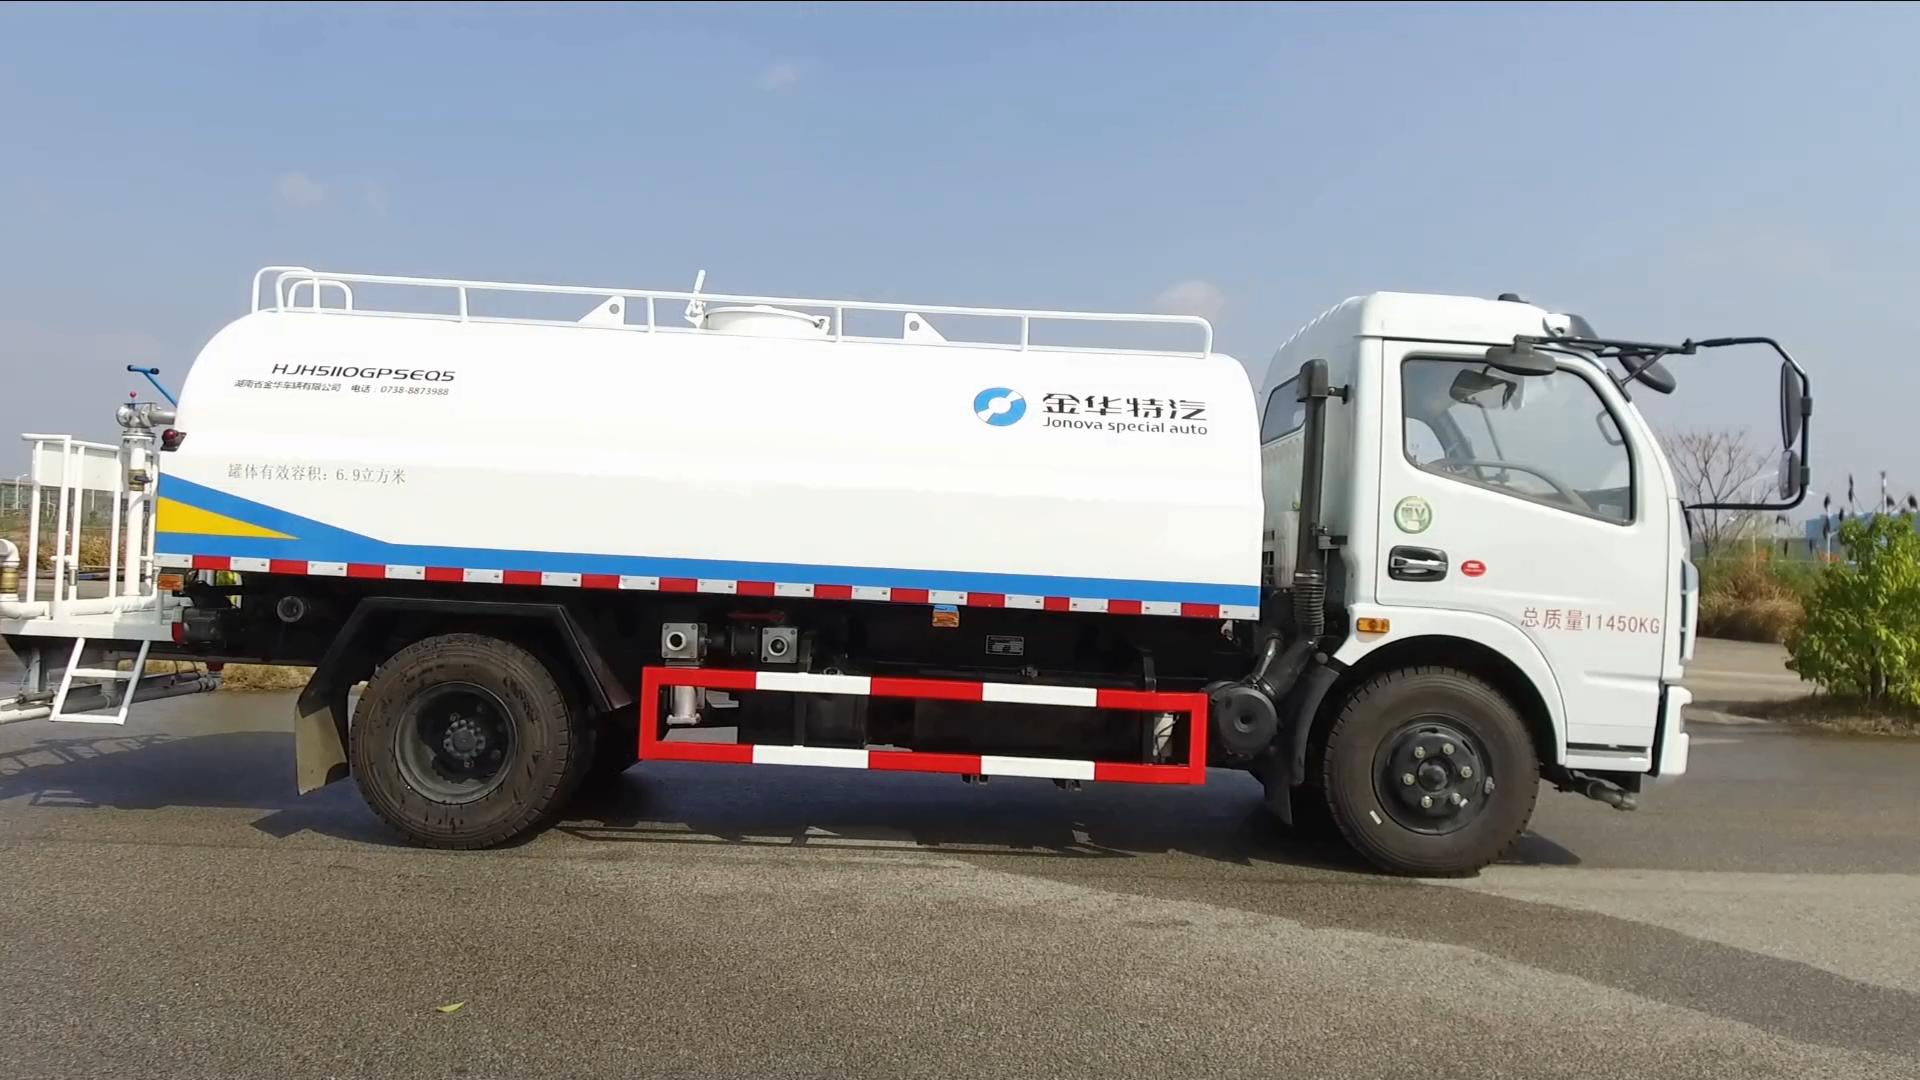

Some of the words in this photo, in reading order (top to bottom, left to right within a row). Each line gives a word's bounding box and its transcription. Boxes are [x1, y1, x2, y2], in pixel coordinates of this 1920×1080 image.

[272, 363, 456, 382] HJH5110GPSEQ5
[233, 379, 342, 392] 湖南省金华车辆有限公司
[1043, 393, 1207, 421] 金华特汽
[1042, 416, 1103, 430] Jonova
[1108, 421, 1165, 434] special
[1169, 424, 1208, 435] auto
